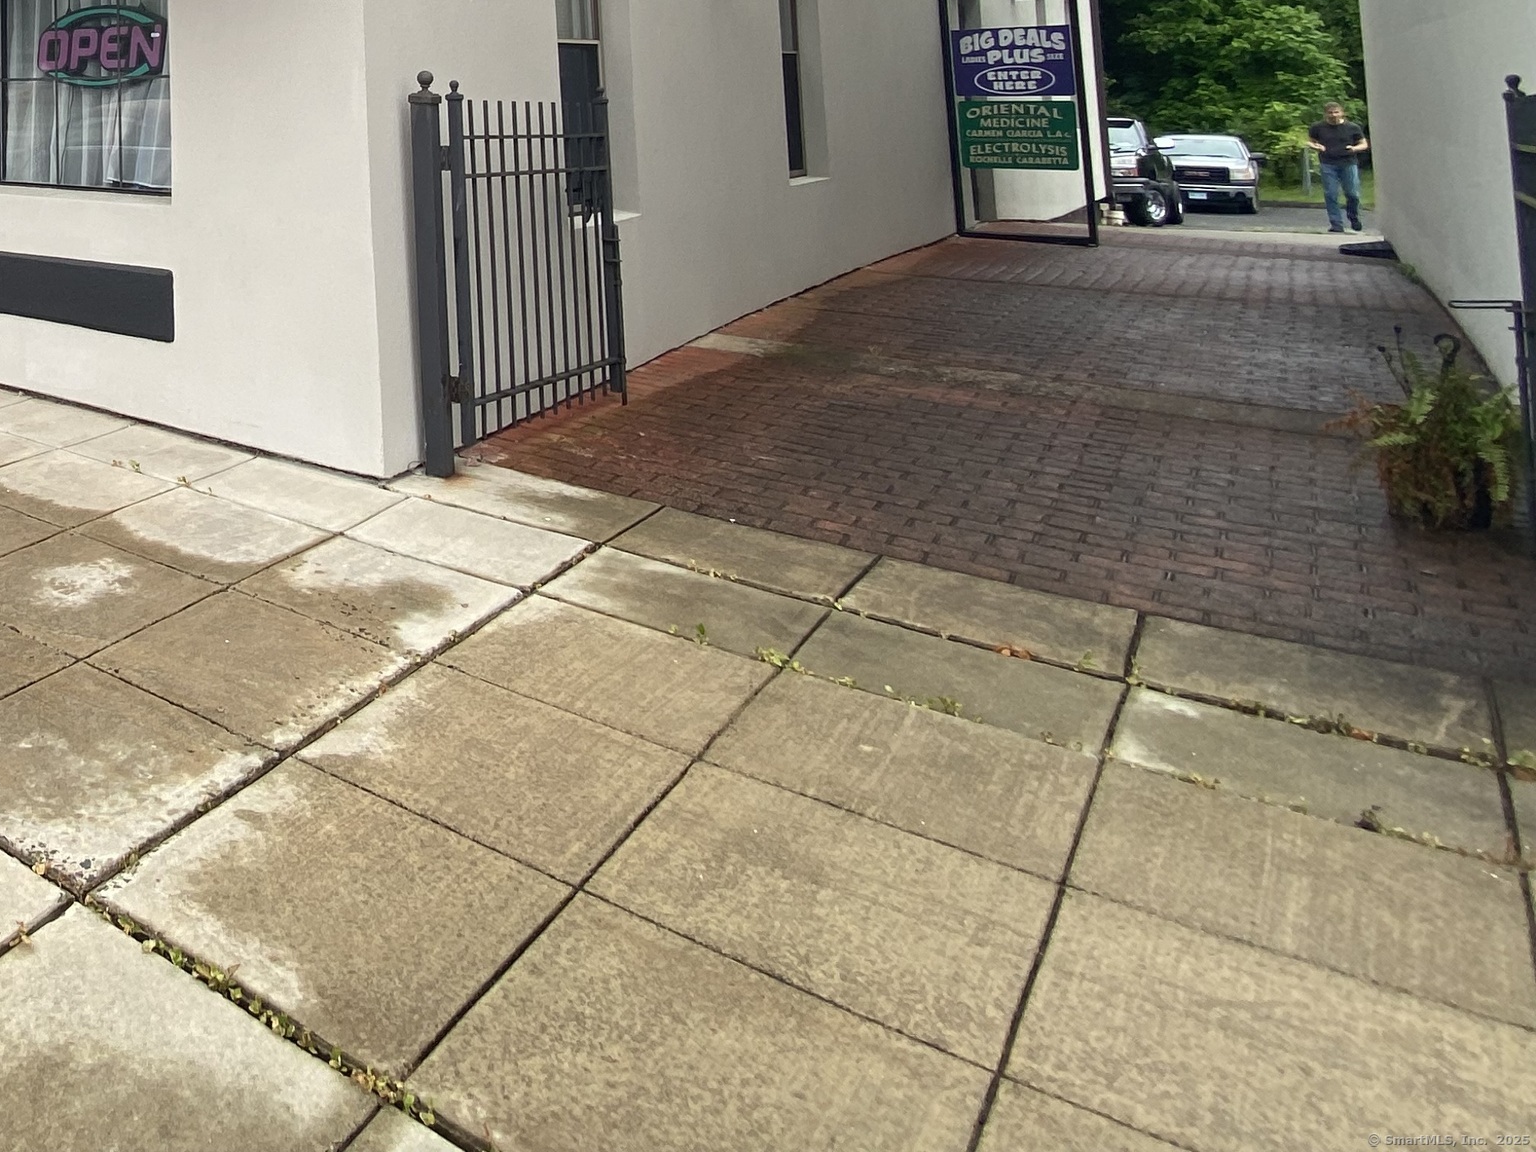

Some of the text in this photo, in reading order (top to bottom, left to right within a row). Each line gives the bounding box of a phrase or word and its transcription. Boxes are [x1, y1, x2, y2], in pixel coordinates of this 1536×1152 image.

[37, 24, 163, 72] OPEN
[959, 28, 1066, 55] BIG DEALS
[986, 48, 1045, 65] PLUS
[986, 70, 1042, 80] ENTER
[992, 81, 1038, 90] HERE
[966, 104, 1063, 119] ORIENTAL
[980, 118, 1050, 127] MEDICINE
[966, 129, 1003, 137] CARMEN
[970, 142, 1068, 156] ELECTROLYSIS
